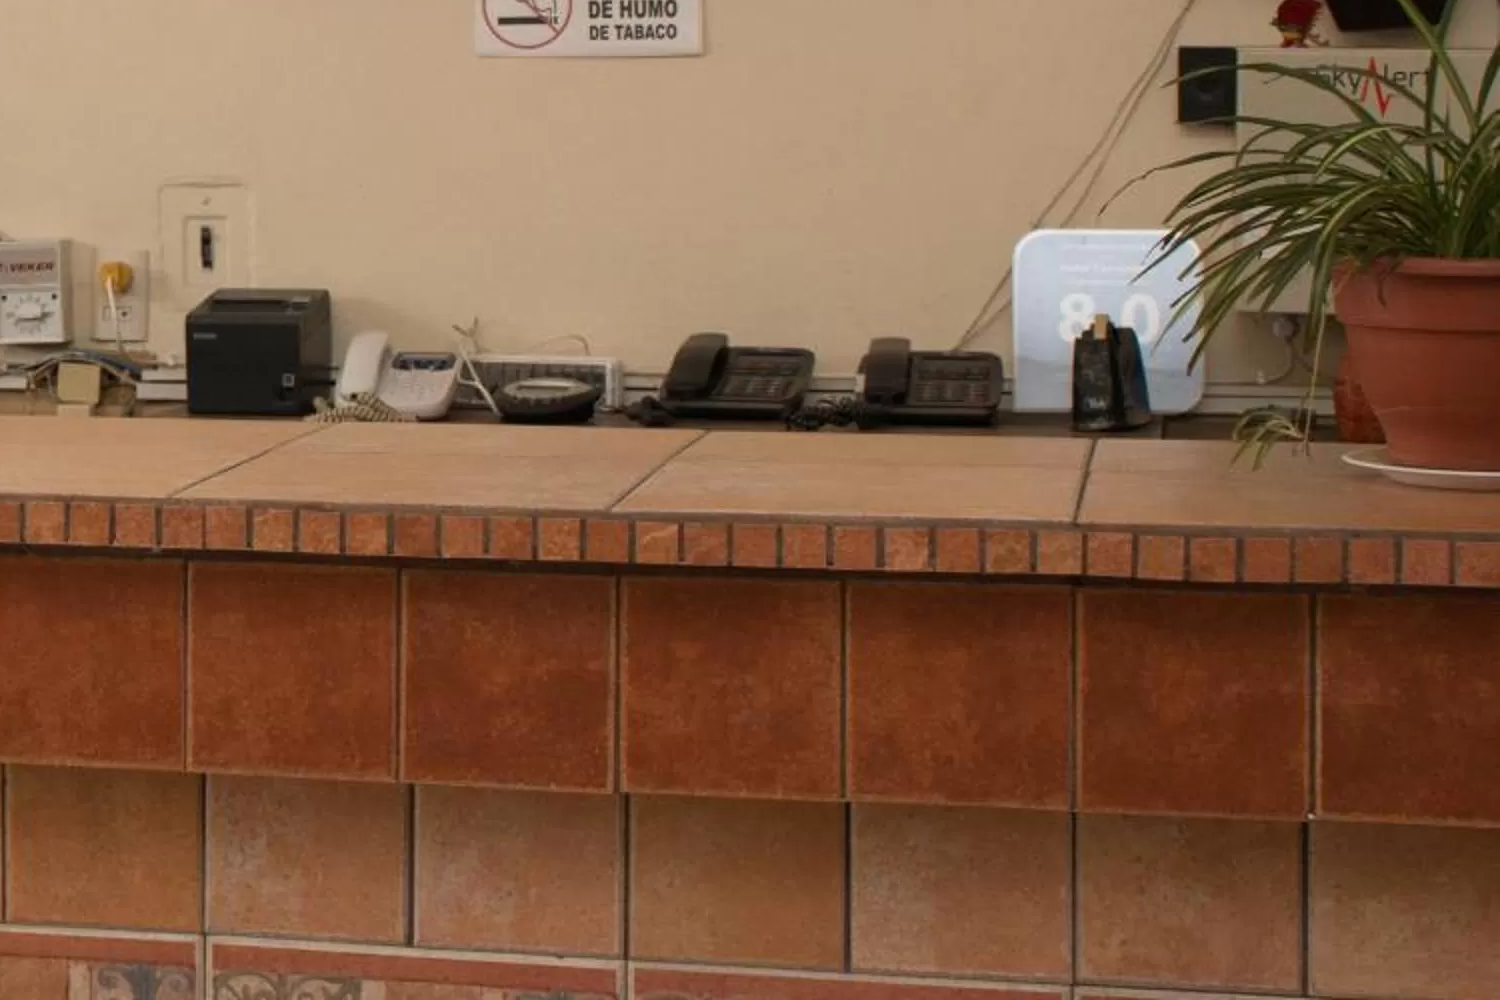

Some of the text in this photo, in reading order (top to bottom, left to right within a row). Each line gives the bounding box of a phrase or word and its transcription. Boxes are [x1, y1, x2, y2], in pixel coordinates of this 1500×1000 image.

[588, 0, 678, 18] DE HUMO
[589, 24, 677, 40] DE TABACO
